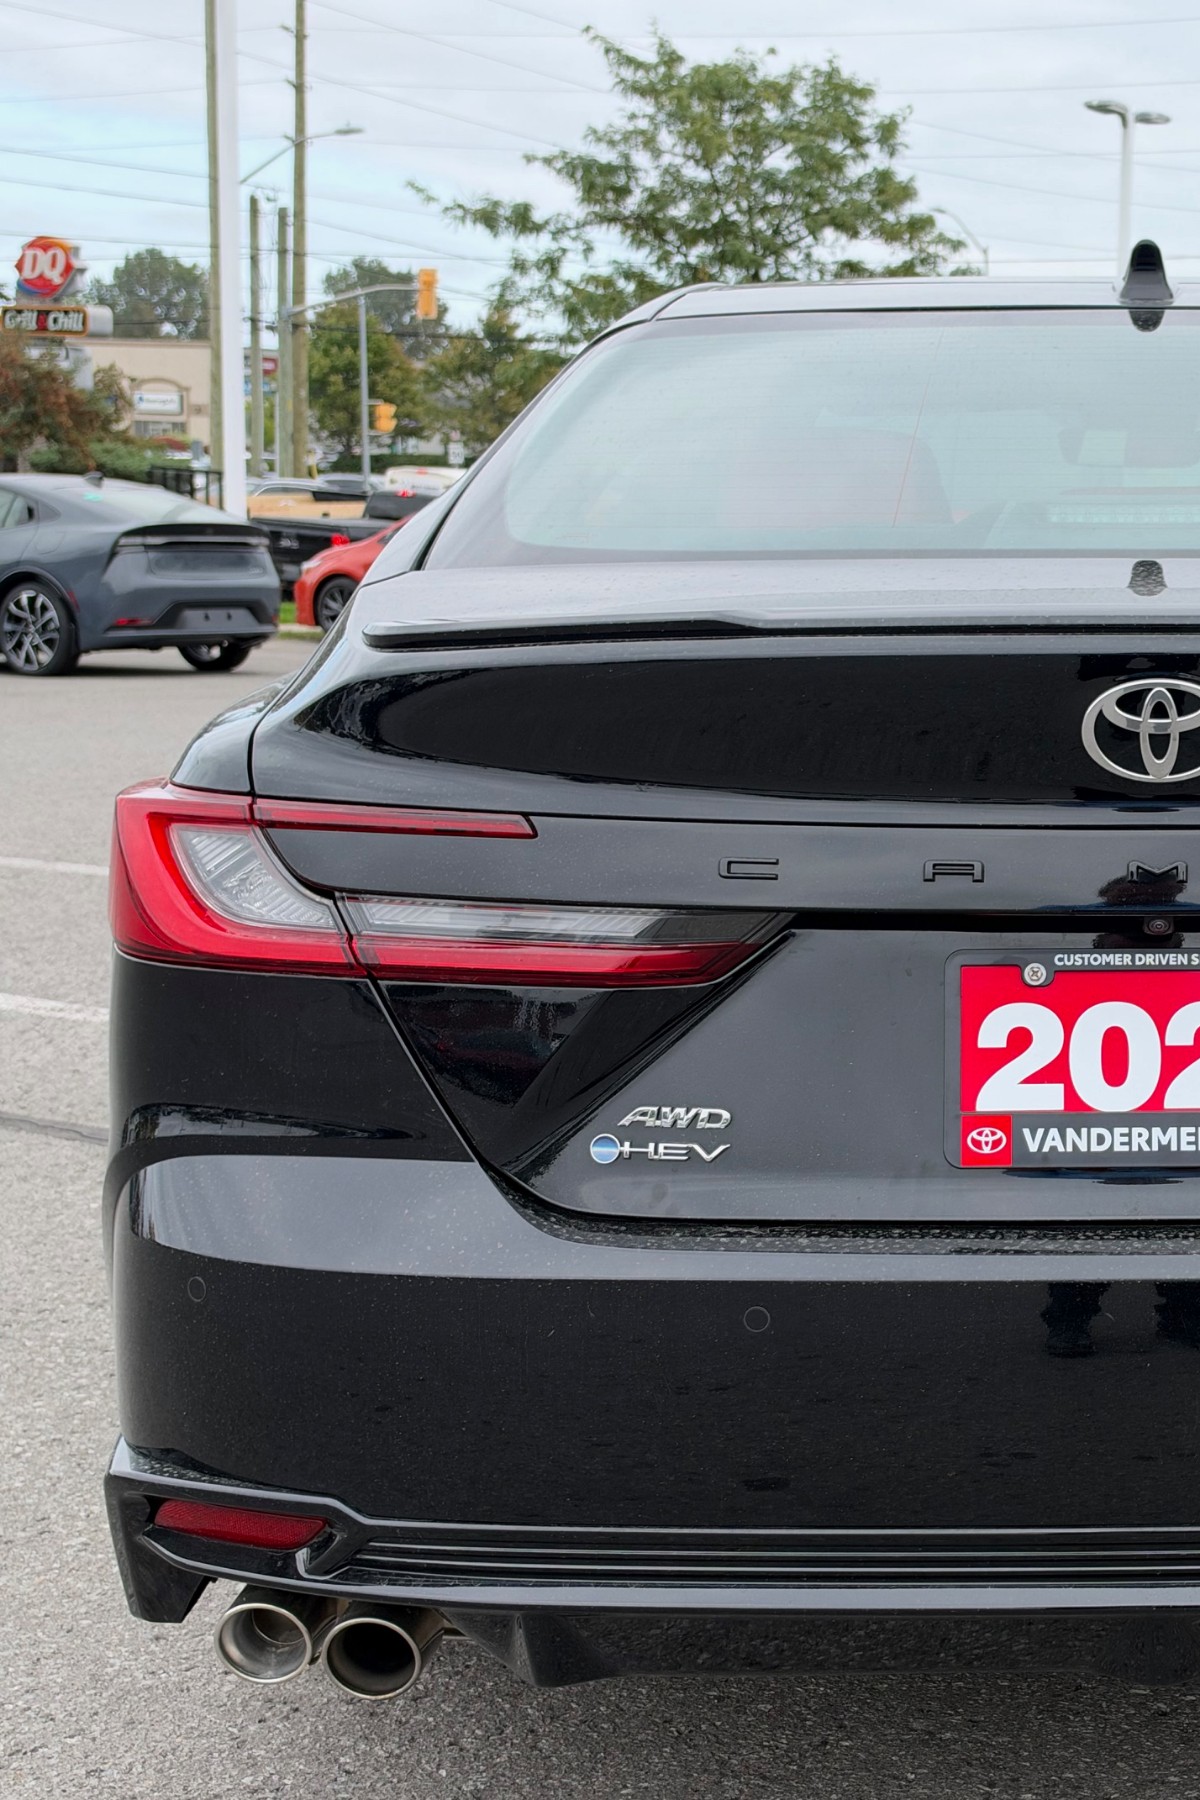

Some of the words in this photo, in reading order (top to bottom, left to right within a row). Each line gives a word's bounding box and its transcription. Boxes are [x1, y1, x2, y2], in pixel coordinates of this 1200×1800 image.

[21, 247, 67, 285] DQ
[47, 311, 84, 331] Chill
[1053, 953, 1133, 966] CUSTOMER
[1134, 953, 1189, 966] DRIVEN
[617, 1105, 732, 1129] AWD
[622, 1141, 731, 1163] HEV
